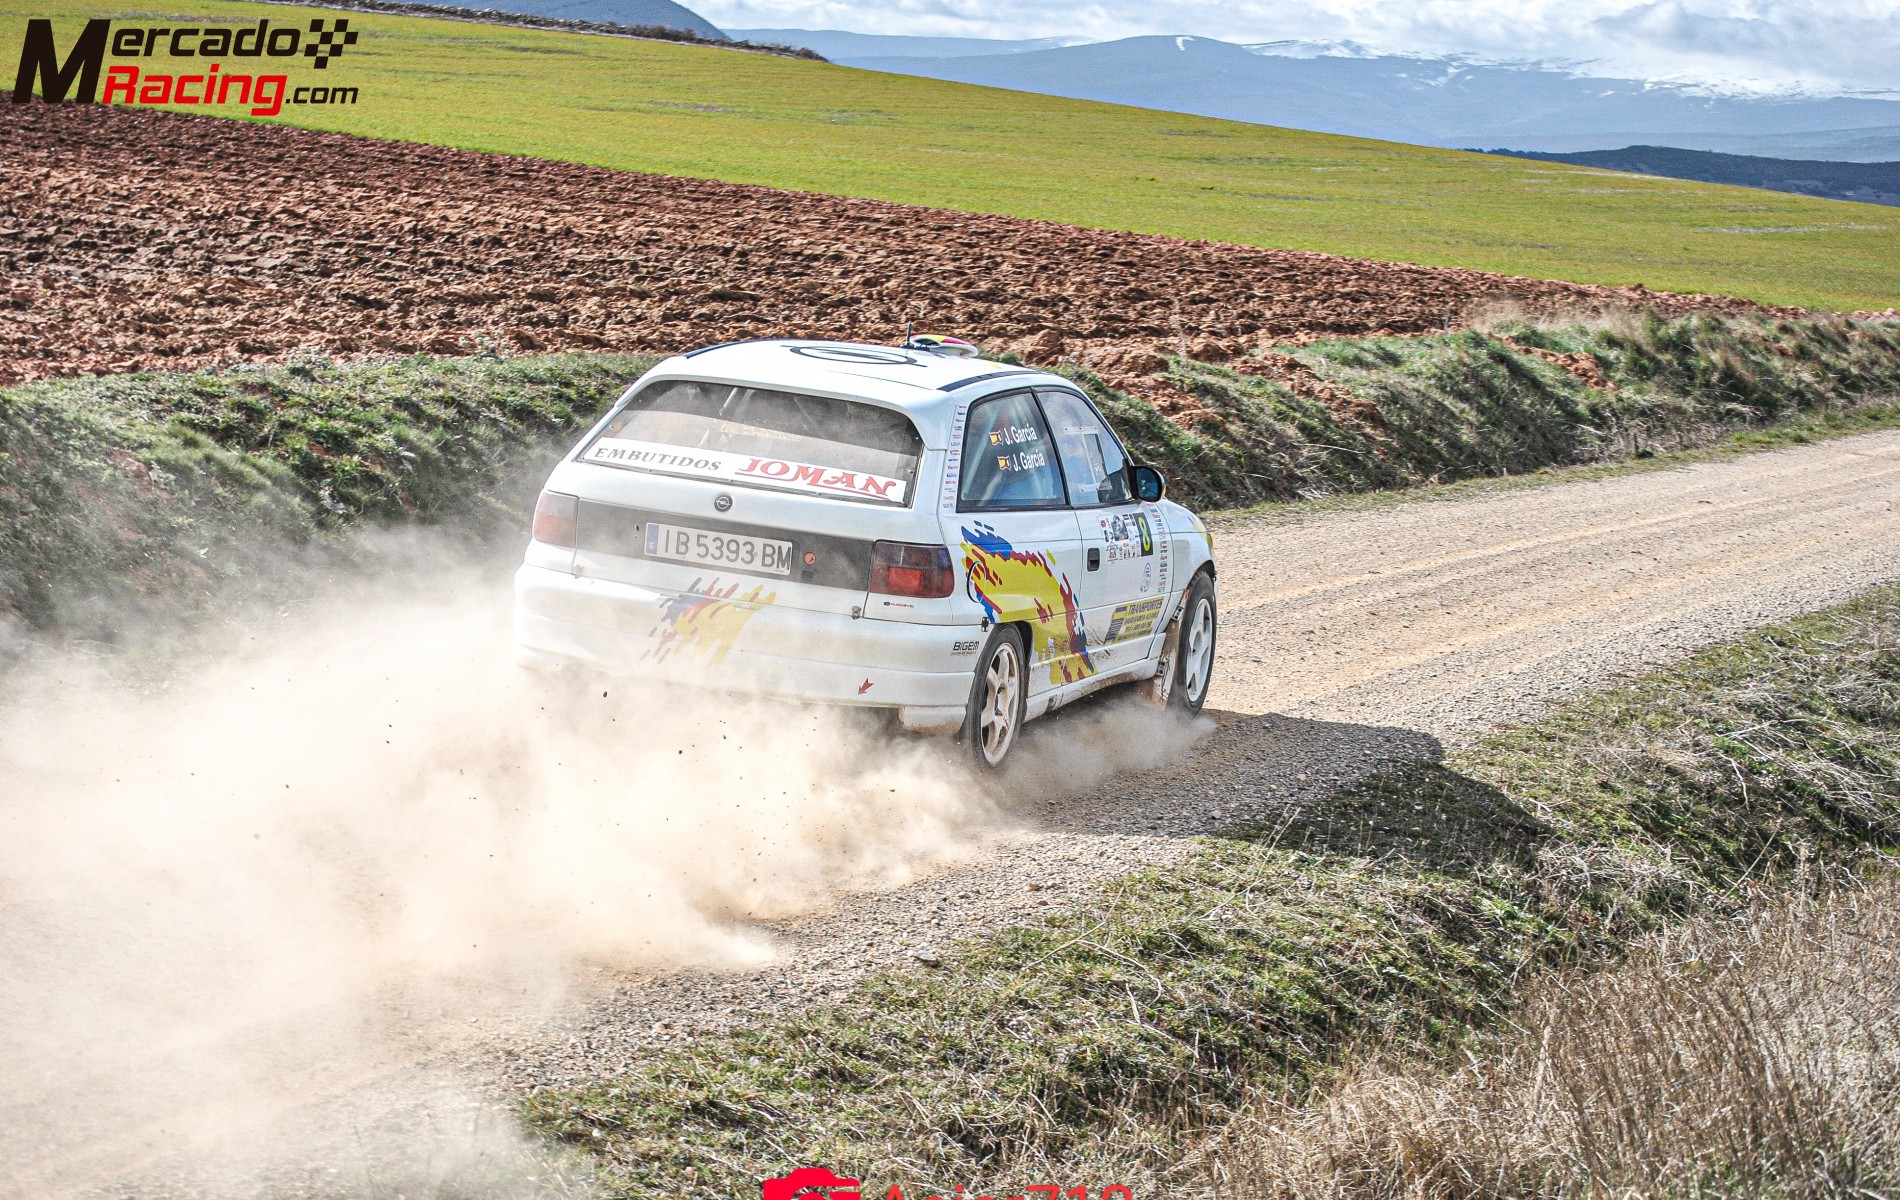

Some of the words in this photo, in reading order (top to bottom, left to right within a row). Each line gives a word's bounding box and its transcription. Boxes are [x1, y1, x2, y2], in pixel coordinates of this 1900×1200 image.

[1003, 427, 1014, 446] J.
[594, 447, 722, 472] EMBUTIDOS
[738, 458, 897, 498] JOMAN
[1012, 453, 1022, 472] J.
[696, 533, 756, 565] 5393
[761, 543, 792, 571] BM
